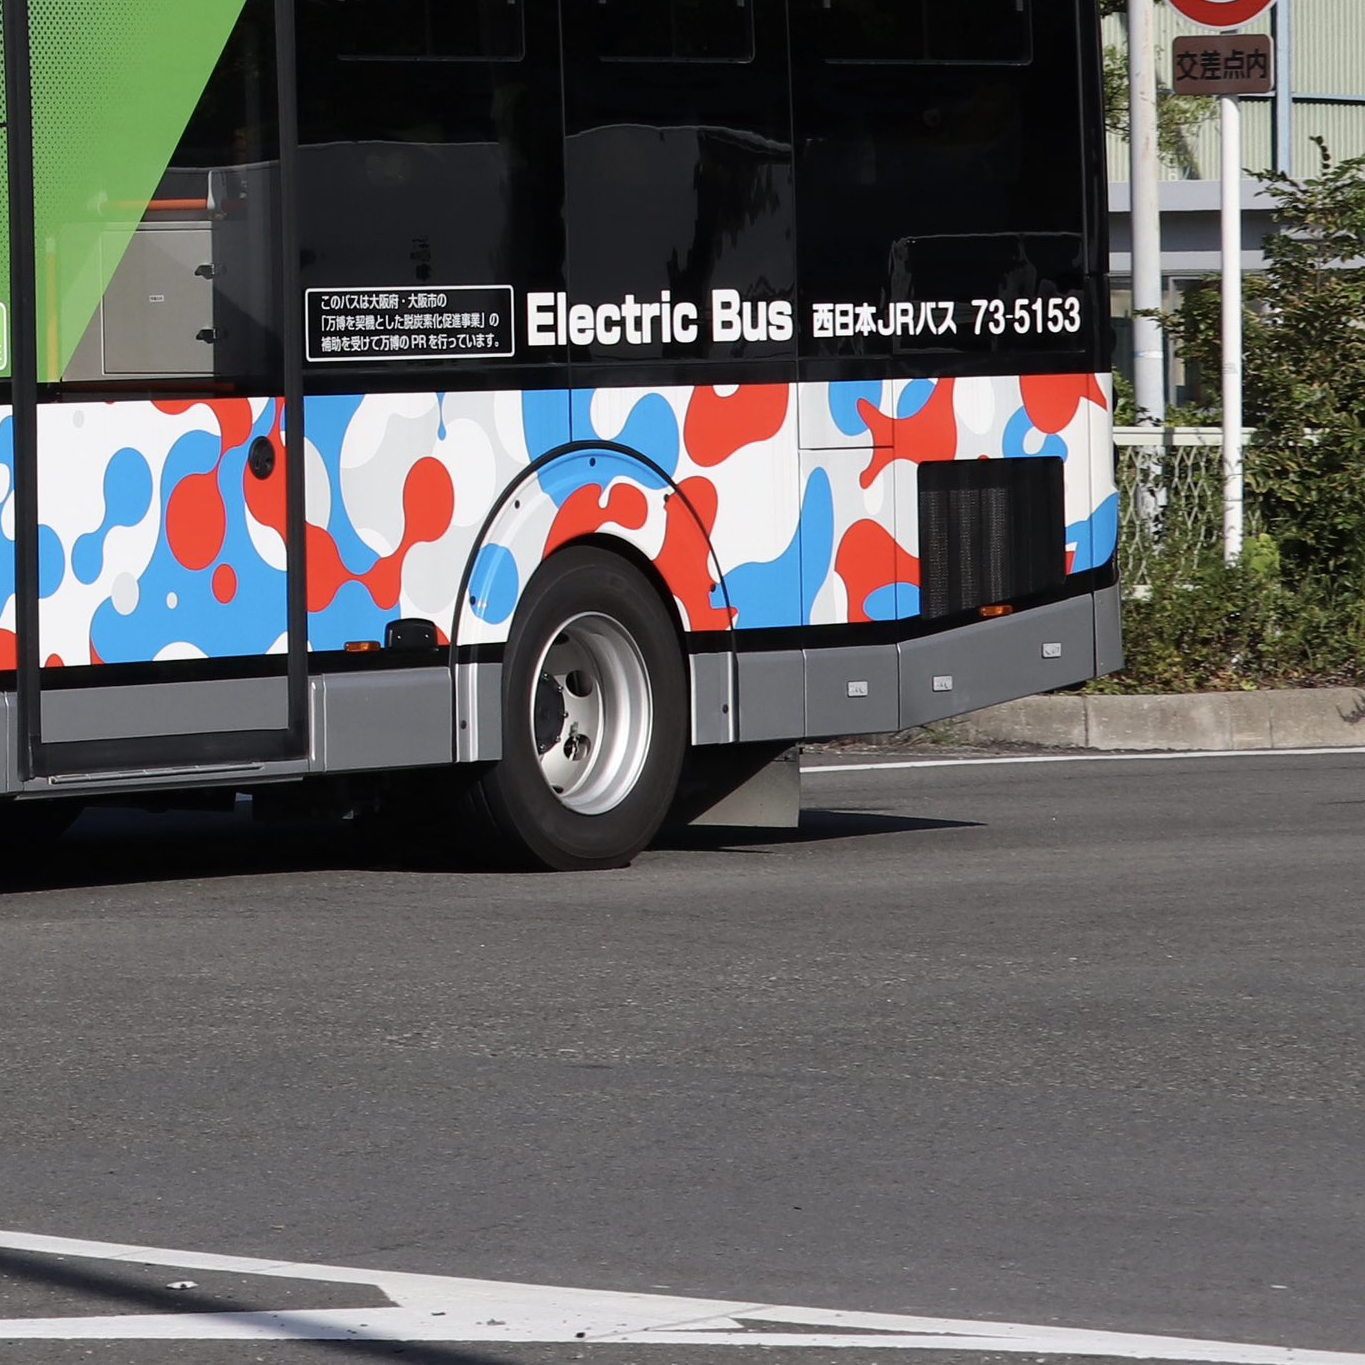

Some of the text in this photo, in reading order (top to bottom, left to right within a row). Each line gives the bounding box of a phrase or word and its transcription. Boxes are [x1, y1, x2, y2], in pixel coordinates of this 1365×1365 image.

[1176, 48, 1268, 81] 交差点内
[320, 293, 447, 310] このバスは大阪府・大阪市の
[526, 288, 794, 346] Electric Bus
[812, 296, 1081, 338] 西日本JRバス 73-5153
